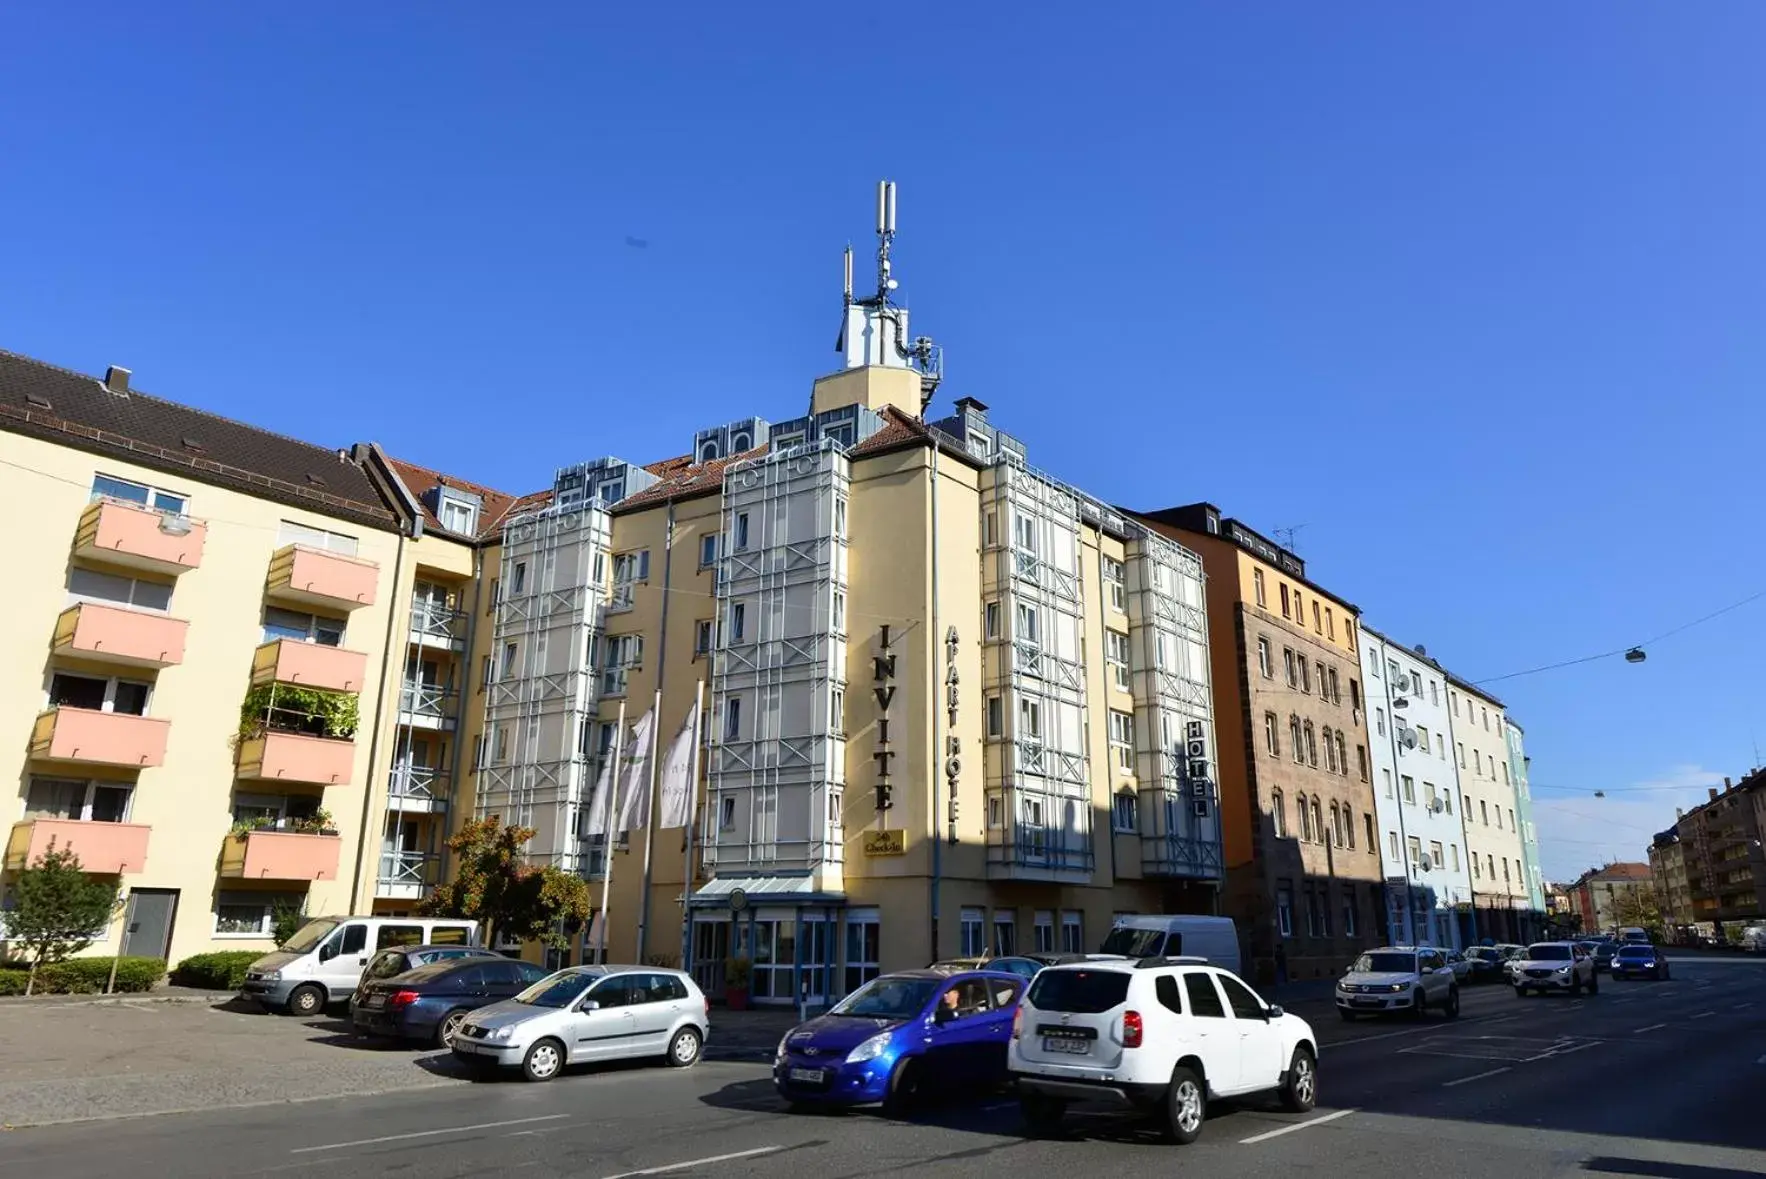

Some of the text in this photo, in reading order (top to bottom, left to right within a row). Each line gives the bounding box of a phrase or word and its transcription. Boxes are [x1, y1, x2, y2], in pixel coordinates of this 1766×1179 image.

[873, 624, 896, 810] INVITE
[944, 624, 961, 846] APART HOTEL
[1188, 722, 1205, 816] HOTEL
